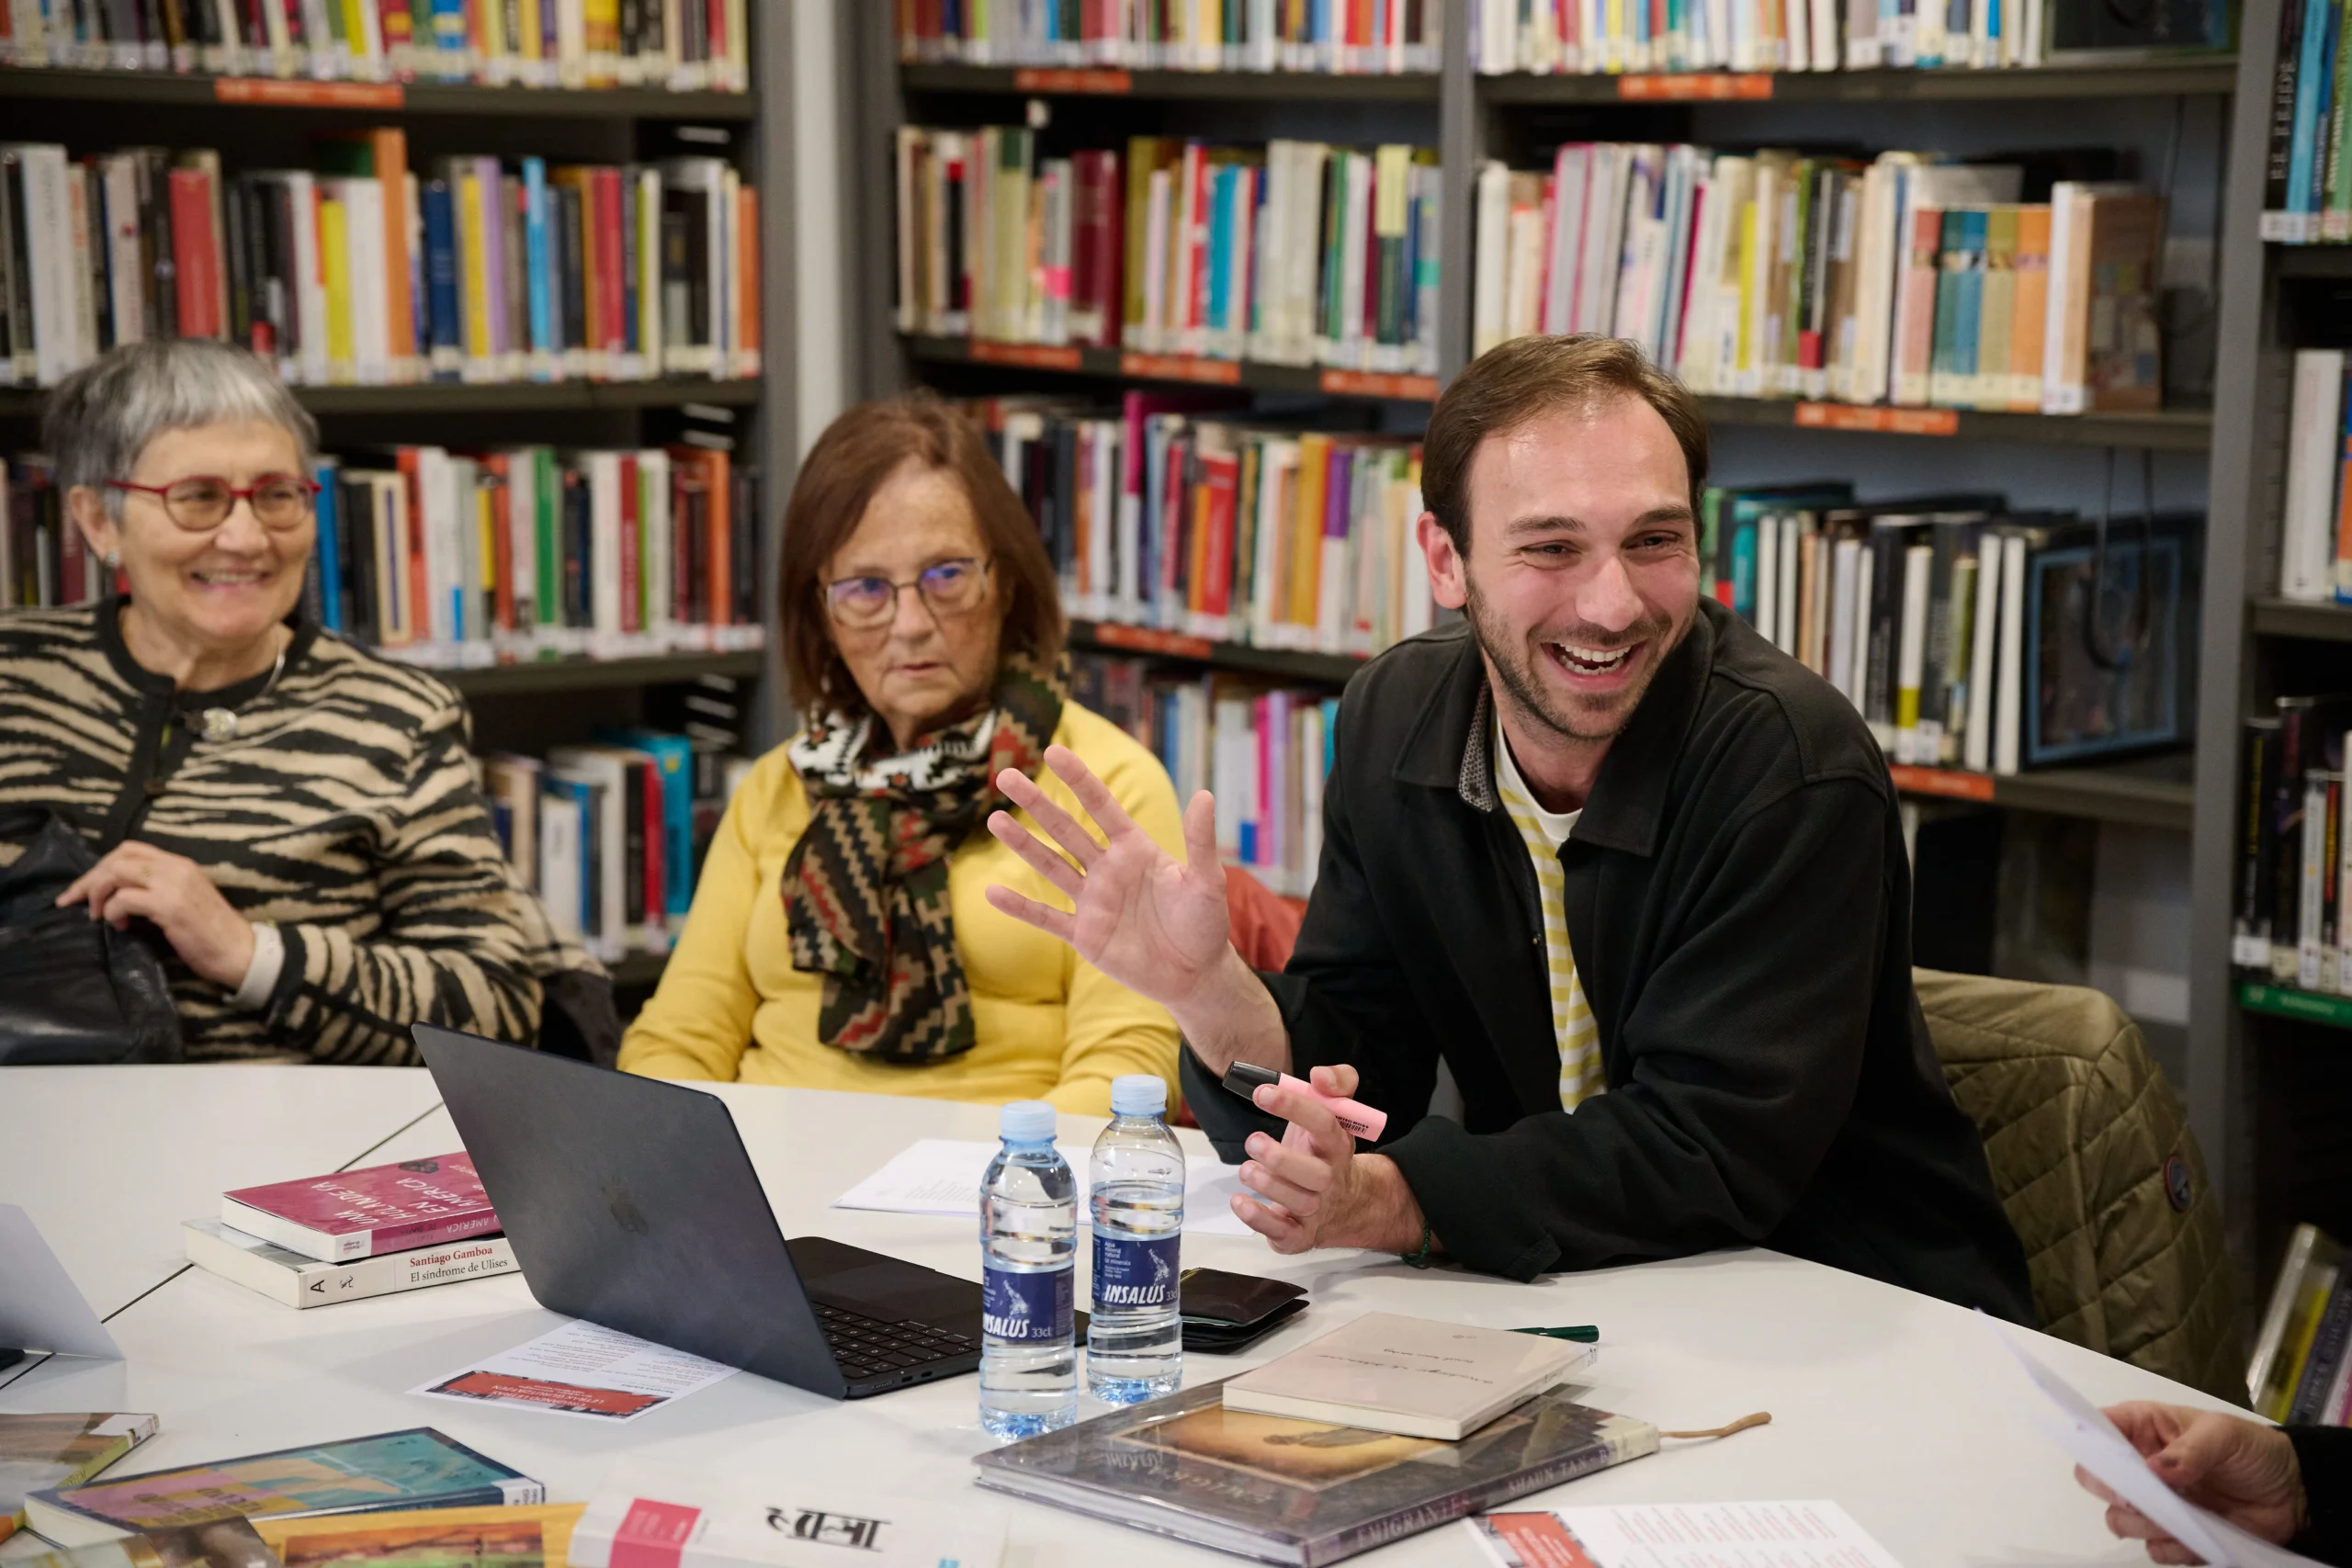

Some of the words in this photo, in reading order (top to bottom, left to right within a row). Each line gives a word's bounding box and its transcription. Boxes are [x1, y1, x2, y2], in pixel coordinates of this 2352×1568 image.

[311, 1181, 417, 1221] HOLANDESA
[395, 1178, 482, 1208] AMÉRICA
[334, 1209, 379, 1225] UNA
[408, 1201, 449, 1214] EN
[447, 1217, 489, 1234] AMÉRICA
[410, 1253, 451, 1268] Santiago
[453, 1246, 493, 1260] Gamboa
[411, 1271, 420, 1282] El
[422, 1264, 466, 1280] síndrome
[468, 1261, 479, 1272] de
[481, 1258, 508, 1270] Ulises
[1103, 1284, 1166, 1304] INSALUS
[983, 1312, 1030, 1337] NSALUS
[1031, 1326, 1052, 1337] 33cl
[1506, 1468, 1555, 1495] SHAUN
[1559, 1456, 1589, 1476] TAN
